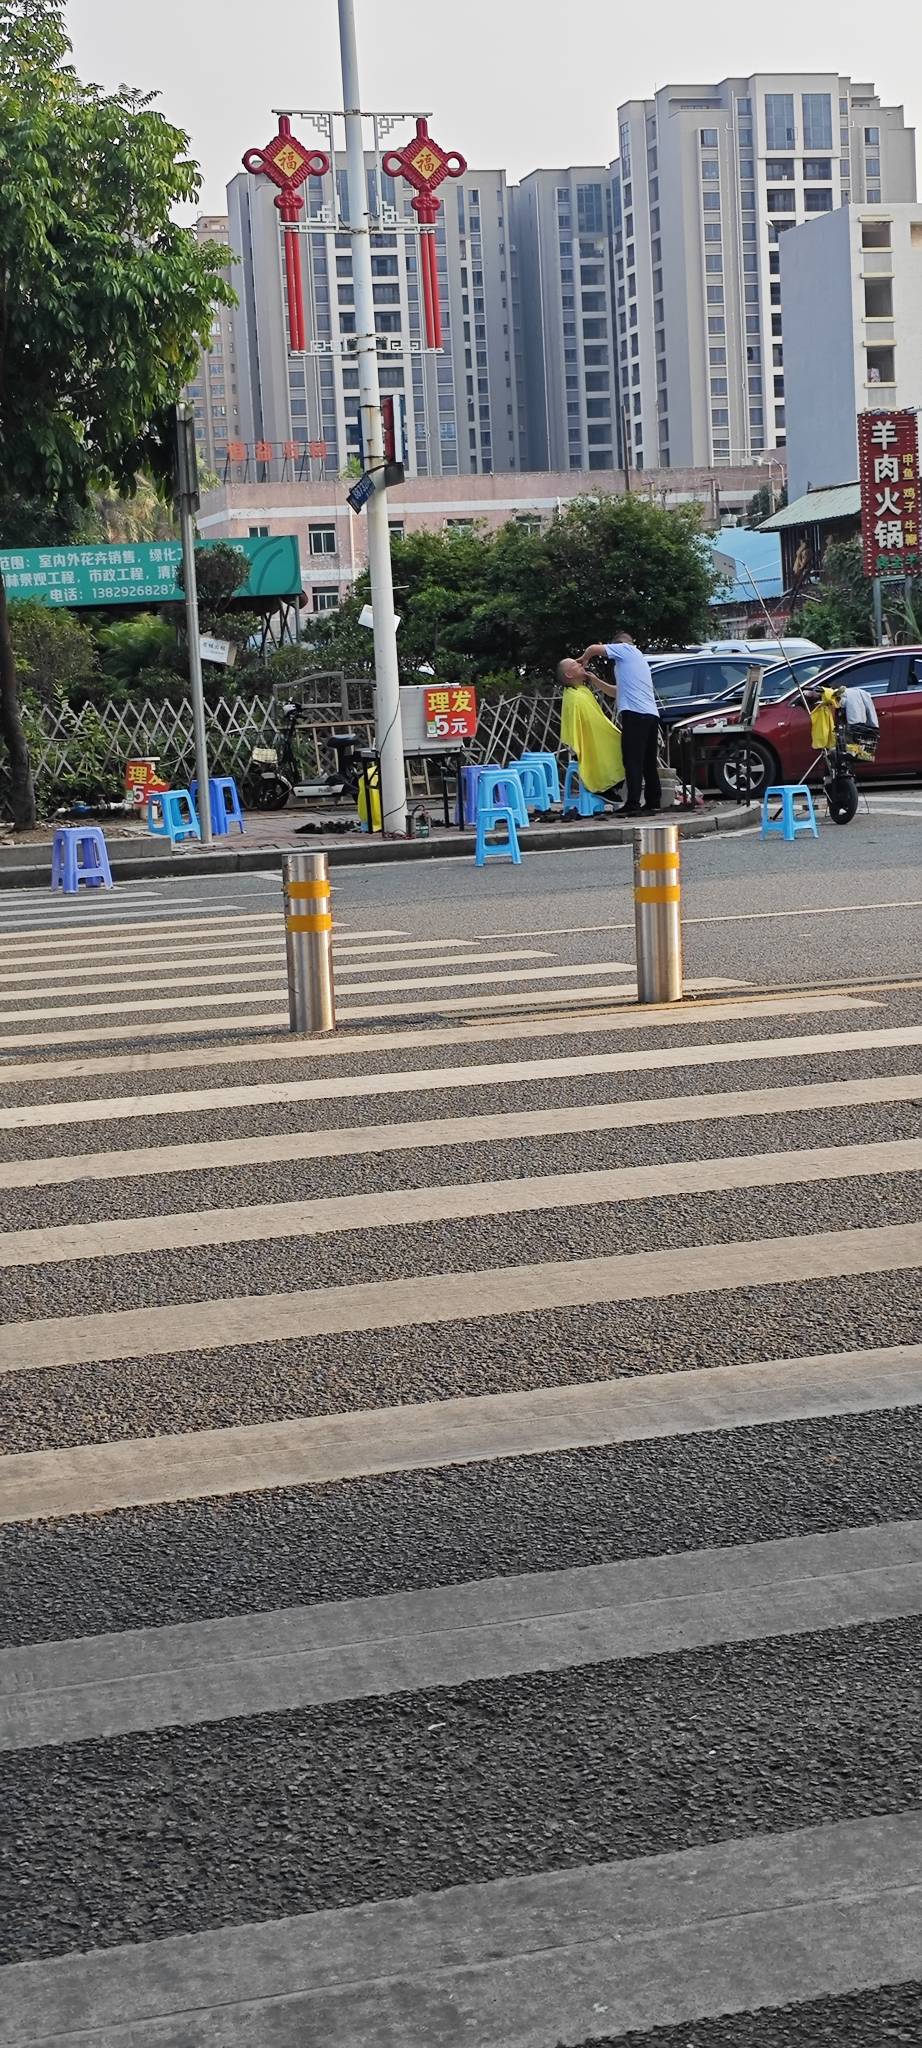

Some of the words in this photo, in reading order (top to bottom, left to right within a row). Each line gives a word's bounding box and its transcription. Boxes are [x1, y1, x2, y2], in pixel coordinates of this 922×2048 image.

[278, 151, 297, 170] 福
[415, 154, 435, 173] 福
[871, 420, 903, 549] 羊肉火锅
[427, 690, 472, 712] 理发
[434, 715, 468, 735] 5元
